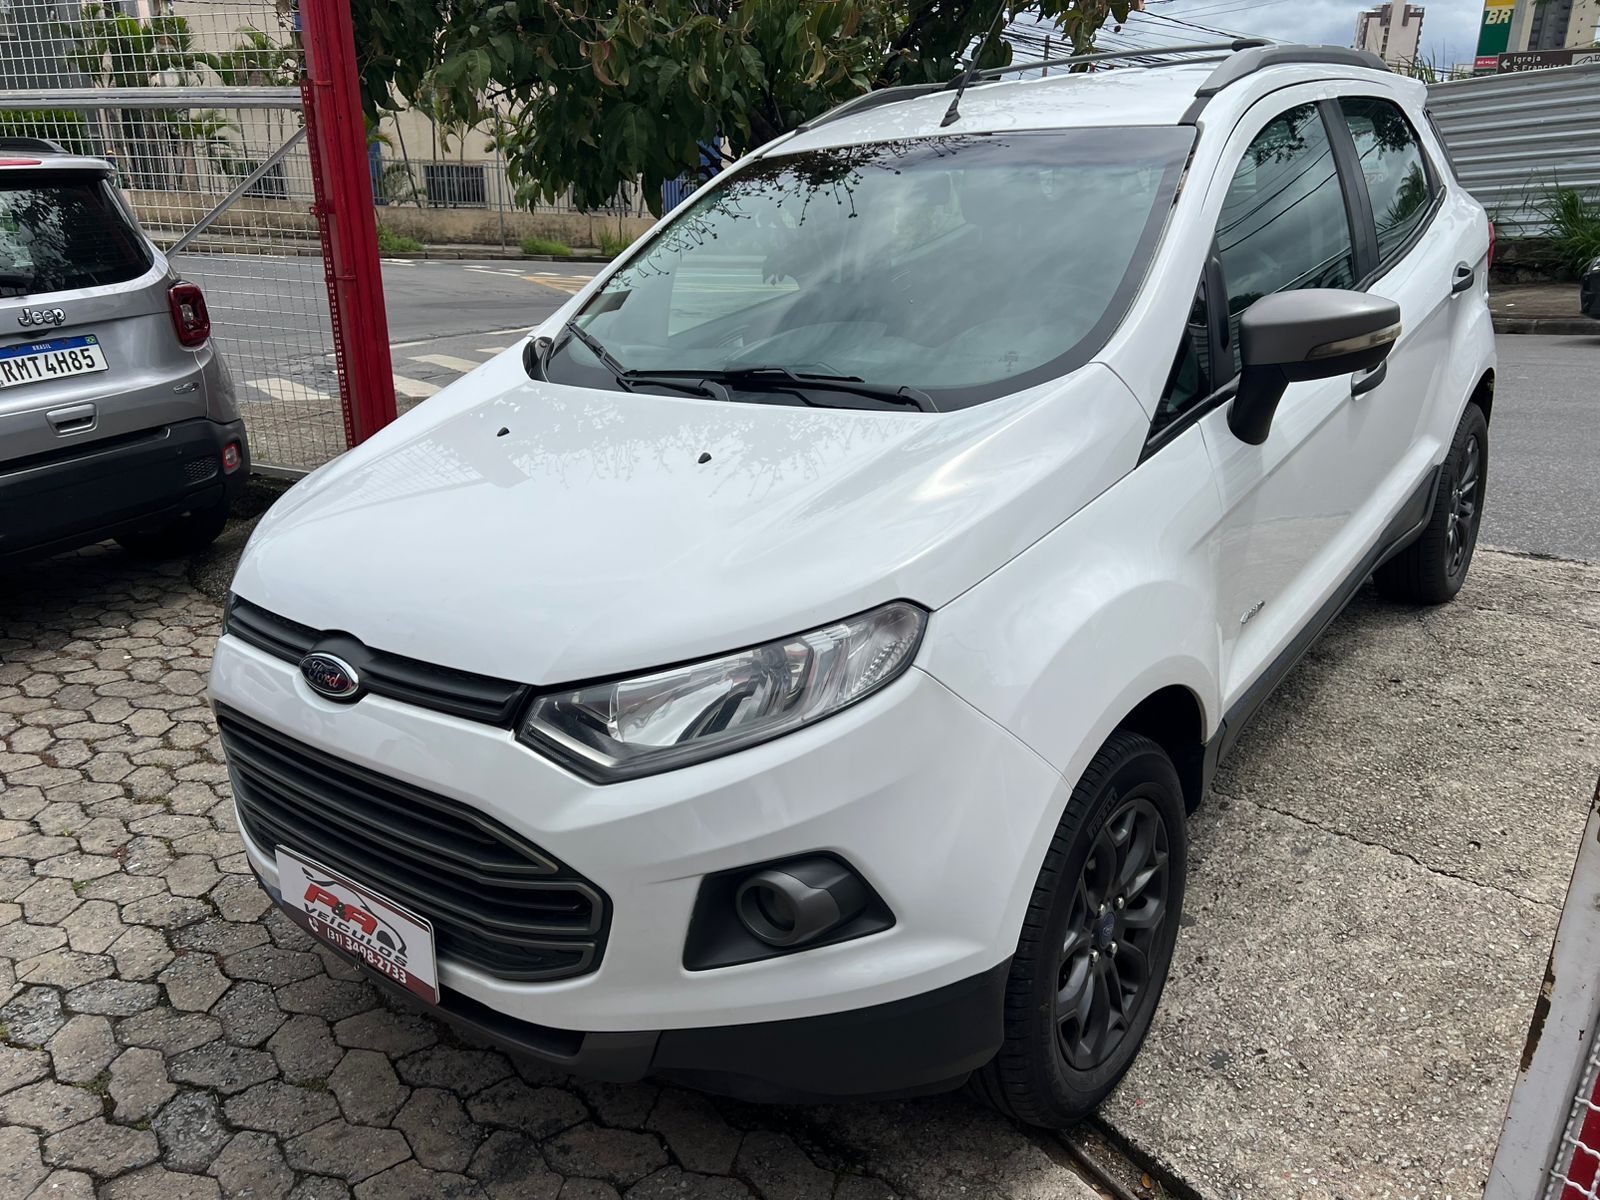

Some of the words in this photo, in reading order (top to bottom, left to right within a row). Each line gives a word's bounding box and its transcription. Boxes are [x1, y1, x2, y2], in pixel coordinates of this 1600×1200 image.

[1485, 10, 1511, 24] BR
[1513, 56, 1541, 64] Igreja
[18, 308, 66, 326] Jeep
[0, 348, 95, 382] RMT4H85
[308, 660, 341, 688] Ford
[304, 903, 408, 967] VEÍCULOS
[327, 928, 343, 945] (31)
[346, 936, 407, 984] 3498-2733
